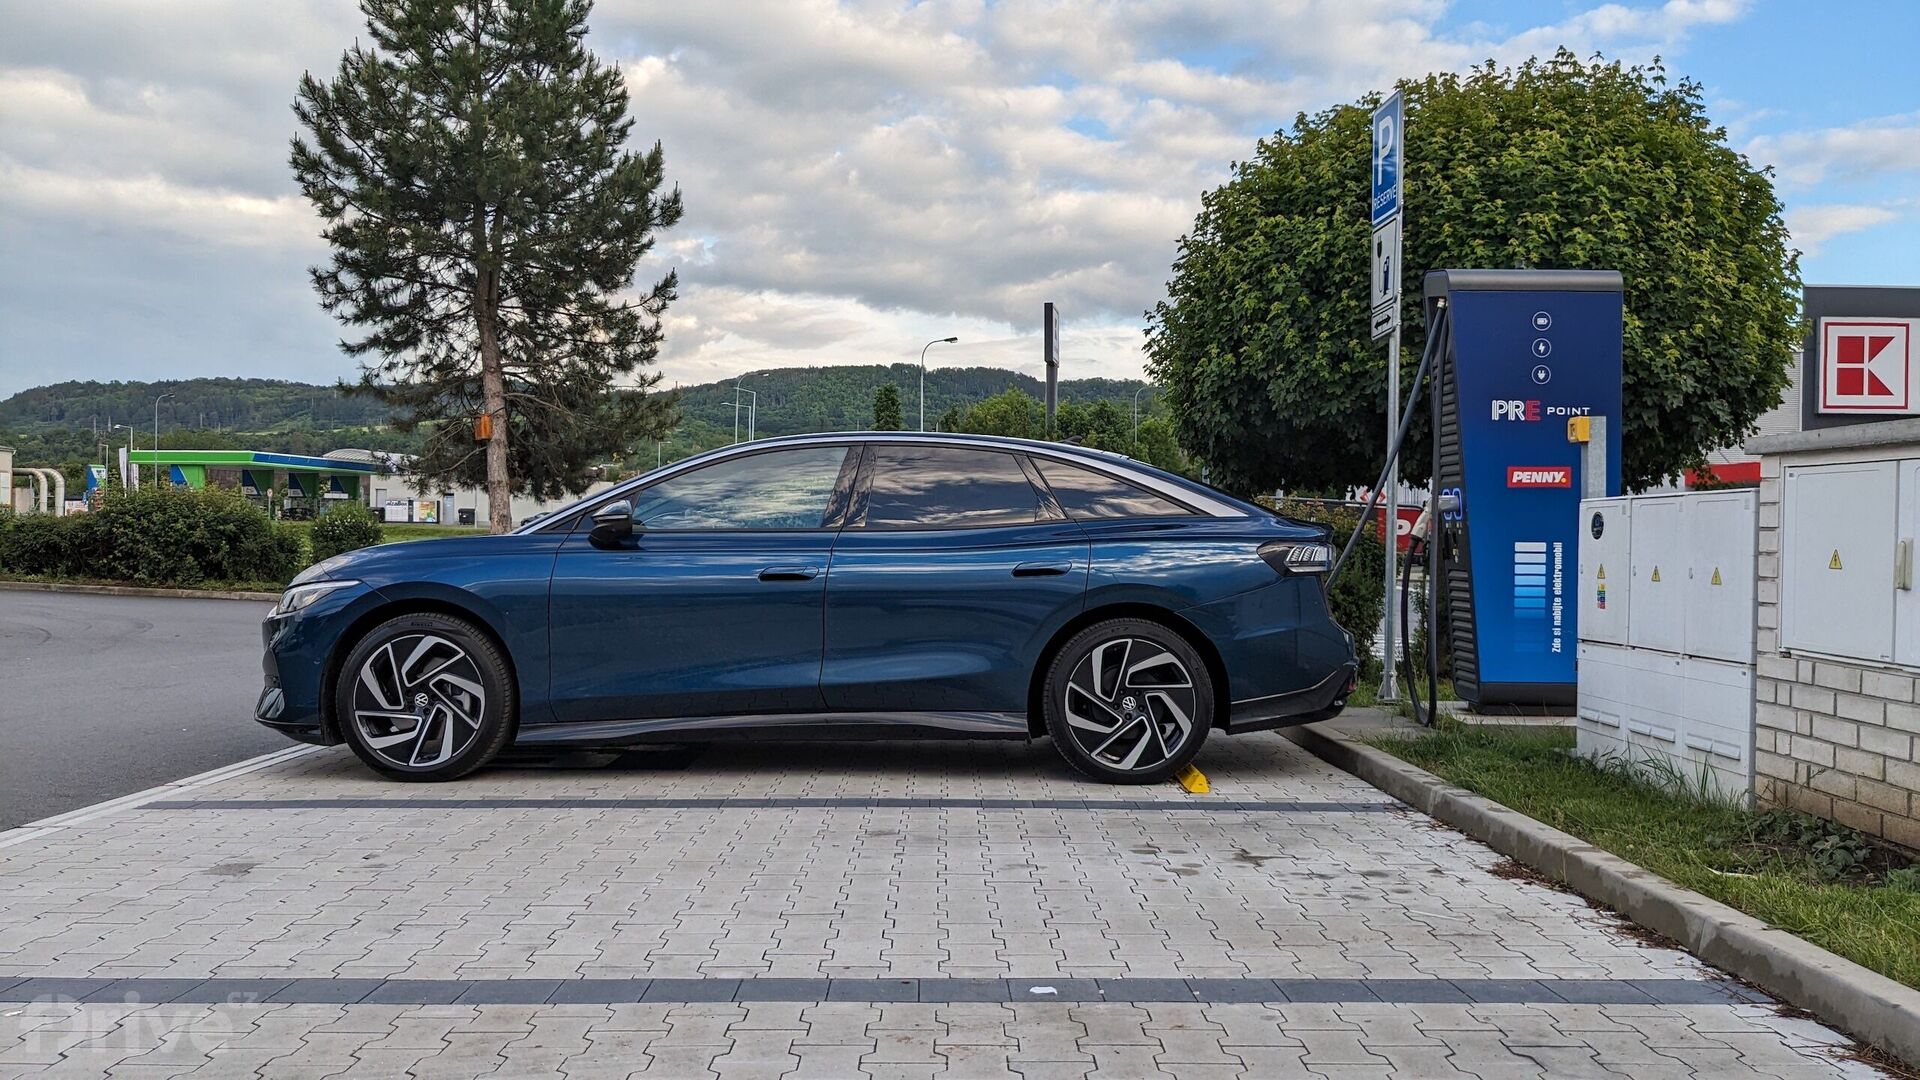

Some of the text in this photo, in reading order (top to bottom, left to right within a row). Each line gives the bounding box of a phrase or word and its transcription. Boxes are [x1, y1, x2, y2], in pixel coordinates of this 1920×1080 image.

[1377, 115, 1394, 185] P
[1491, 399, 1591, 421] PRE POINT
[1551, 542, 1563, 653] Zde si nabijte elektromobil
